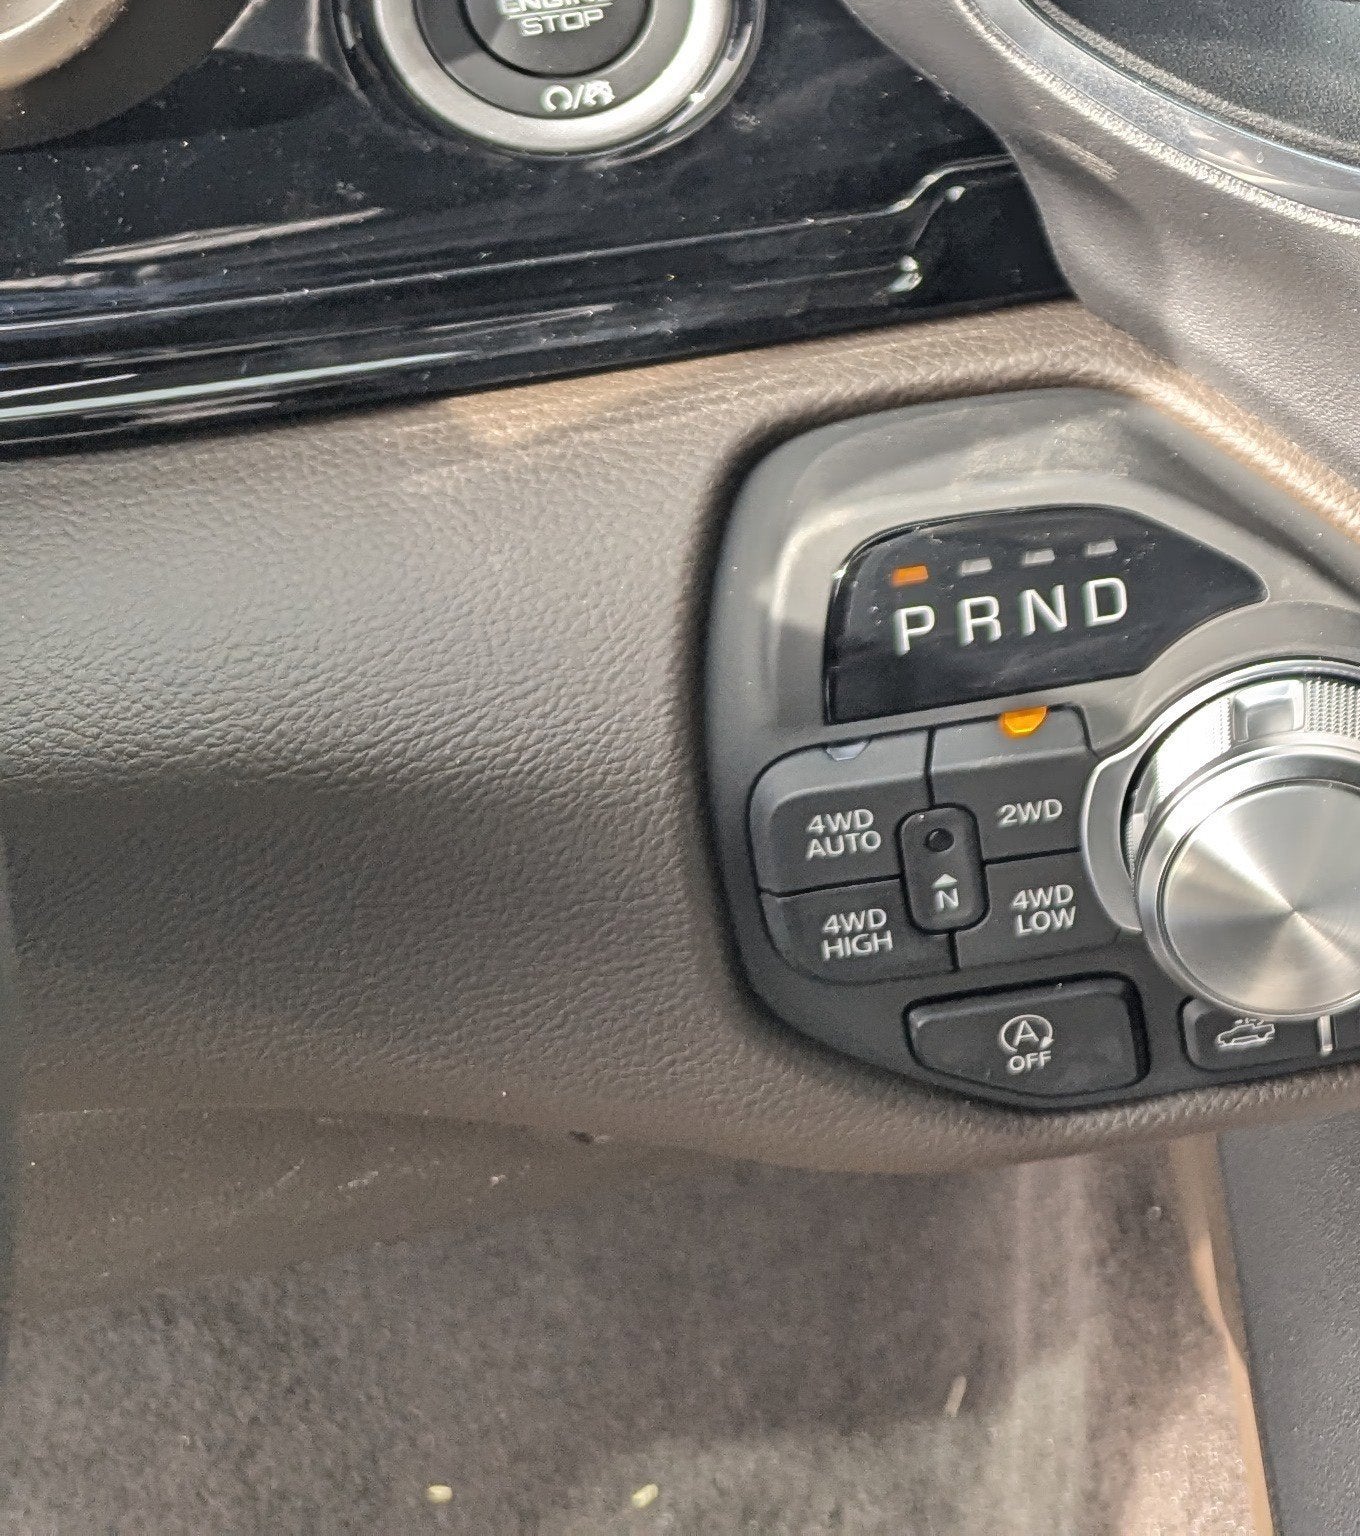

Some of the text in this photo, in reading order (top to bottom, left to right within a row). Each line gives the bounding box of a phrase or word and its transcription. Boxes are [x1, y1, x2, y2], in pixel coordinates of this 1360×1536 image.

[519, 8, 604, 38] STOP
[895, 576, 1128, 656] P R N D
[807, 808, 875, 835] 4WD
[998, 798, 1063, 827] 2WD
[805, 830, 882, 860] AUTO
[1010, 884, 1075, 910] 4WD
[822, 907, 888, 934] 4WD
[1015, 906, 1076, 935] LOW
[822, 930, 893, 961] HIGH
[1005, 1049, 1053, 1075] OFF
